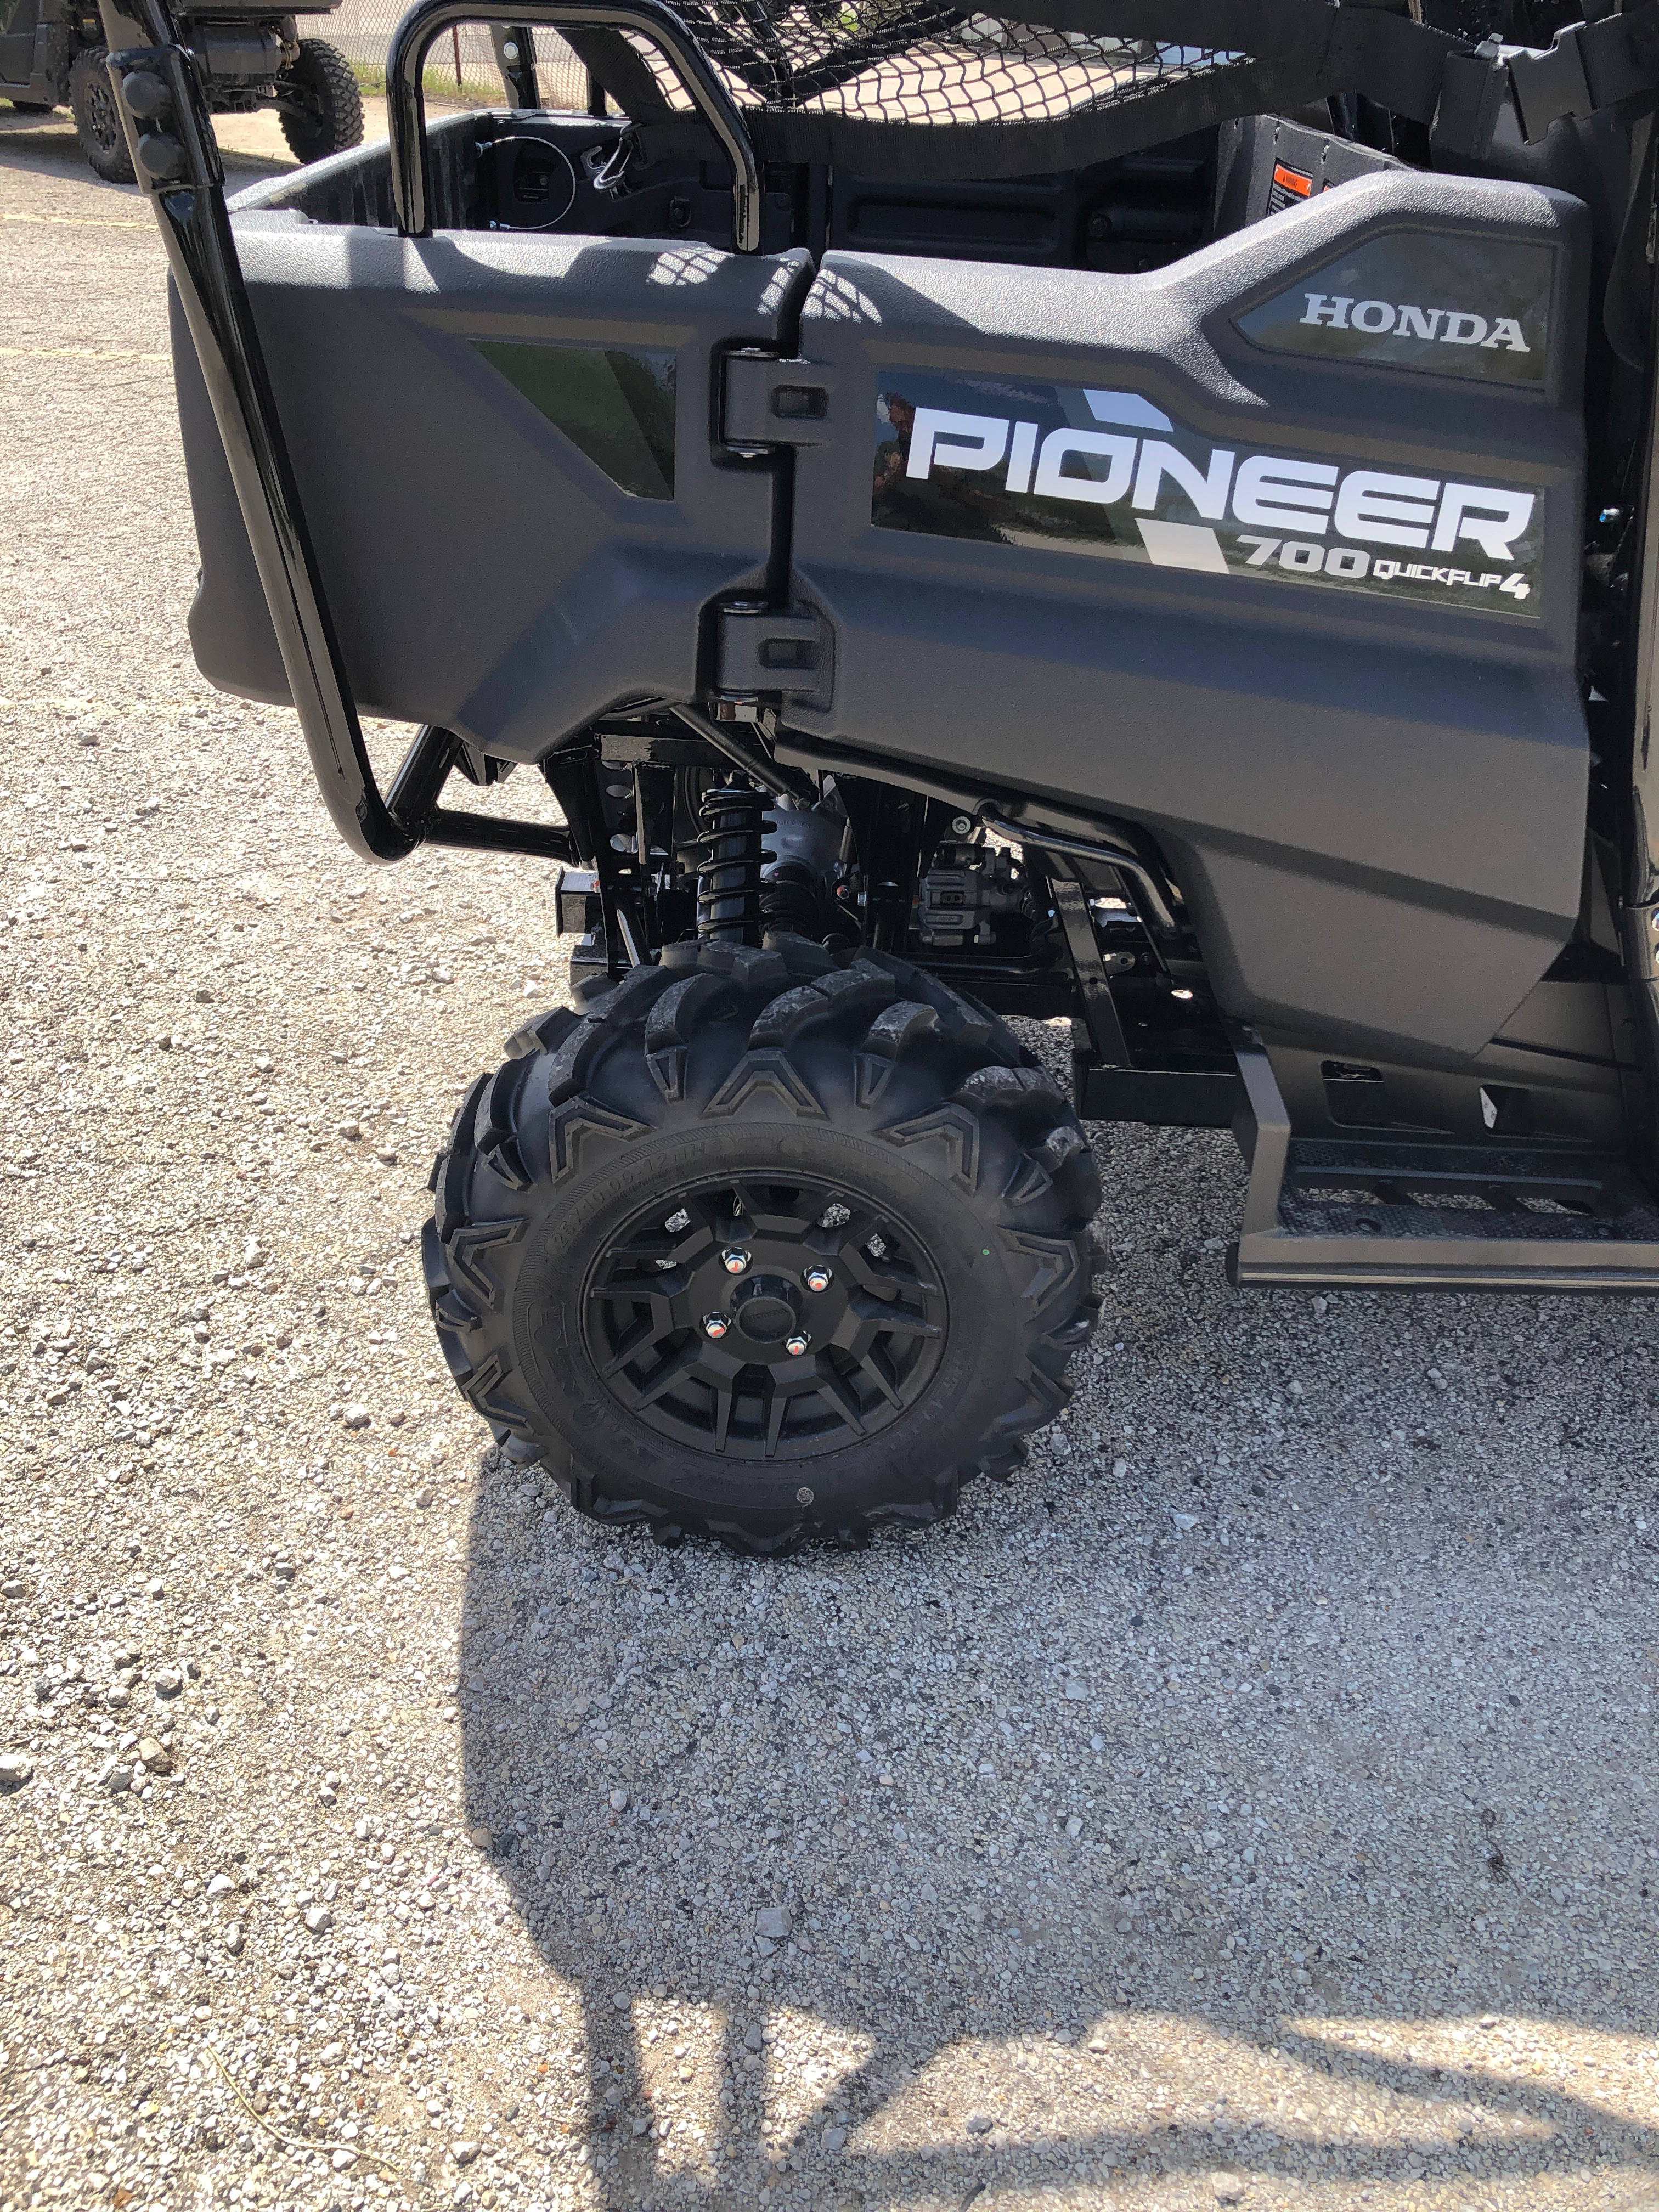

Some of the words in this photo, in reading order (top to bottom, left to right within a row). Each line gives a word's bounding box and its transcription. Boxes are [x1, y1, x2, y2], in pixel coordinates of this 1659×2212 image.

[1299, 293, 1531, 353] HONDA
[906, 407, 1536, 561] PIONEER
[1235, 534, 1371, 579] 700
